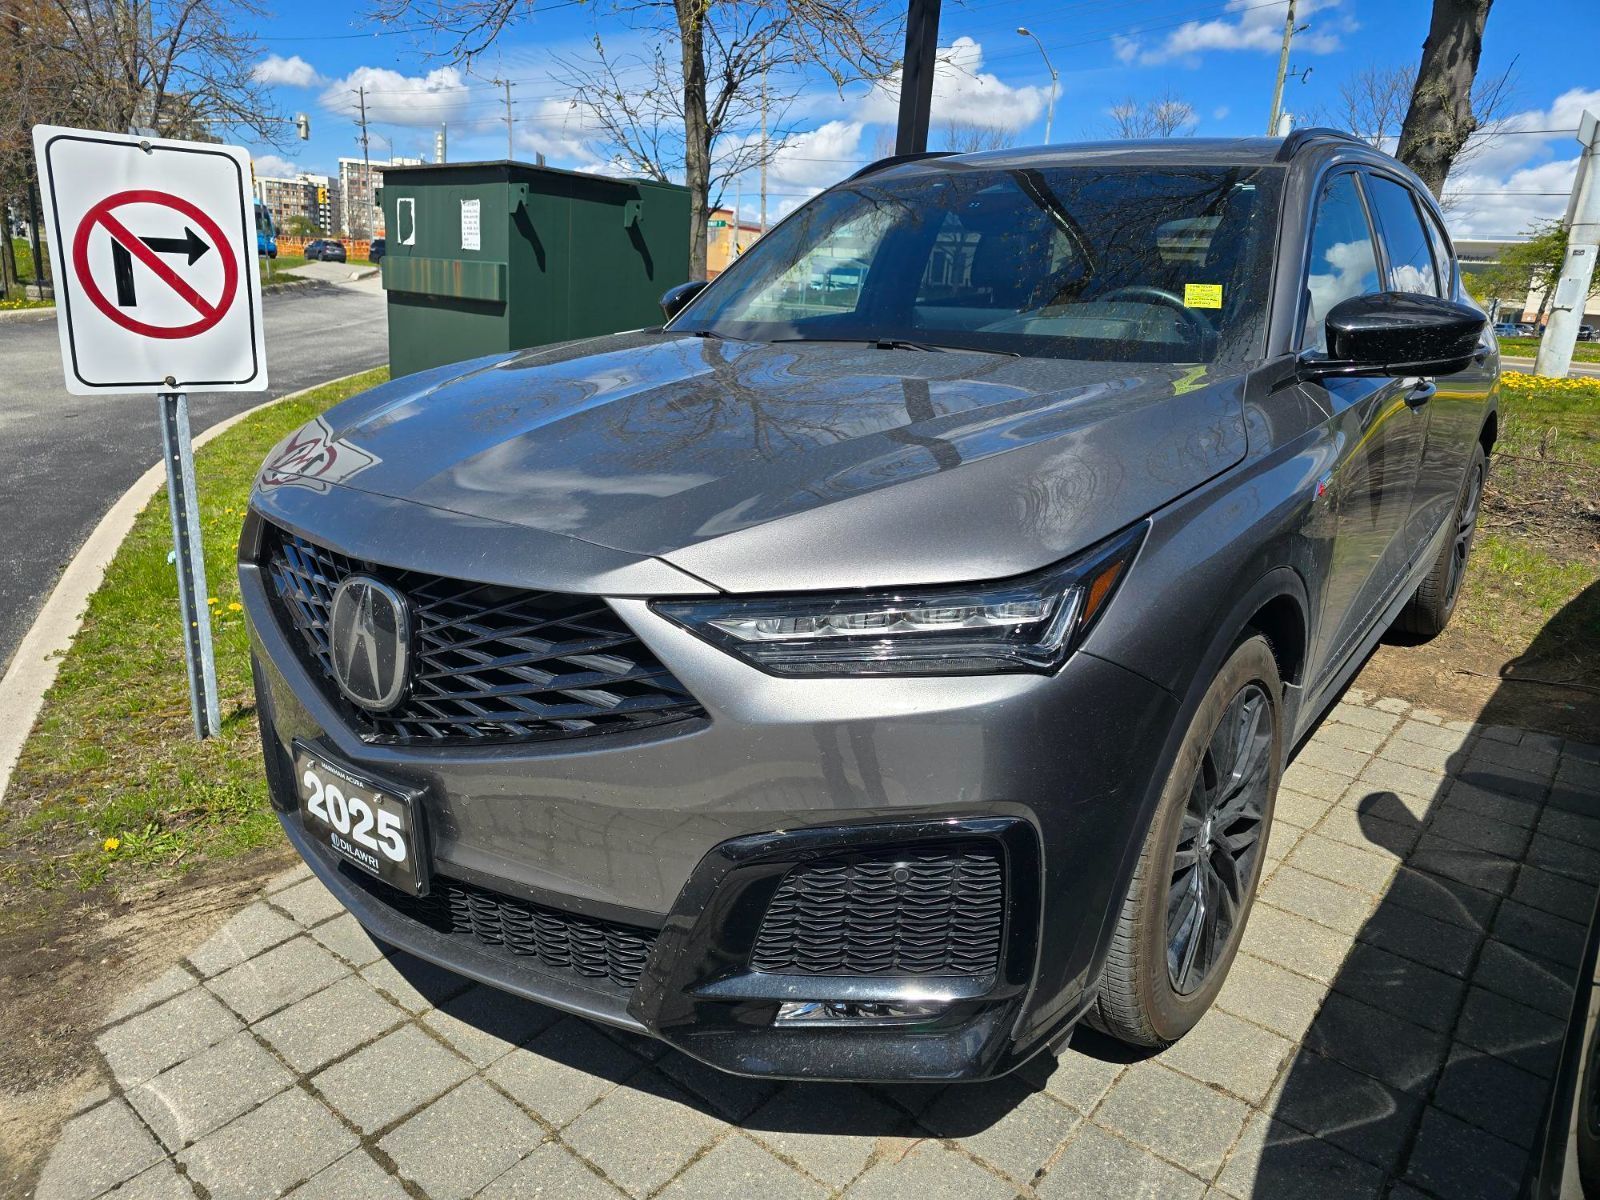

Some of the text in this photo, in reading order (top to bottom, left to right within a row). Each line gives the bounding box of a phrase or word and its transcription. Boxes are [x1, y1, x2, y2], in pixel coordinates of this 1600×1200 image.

[345, 775, 364, 788] ACURA
[303, 770, 407, 862] 2025
[340, 838, 379, 869] DILAWRI
